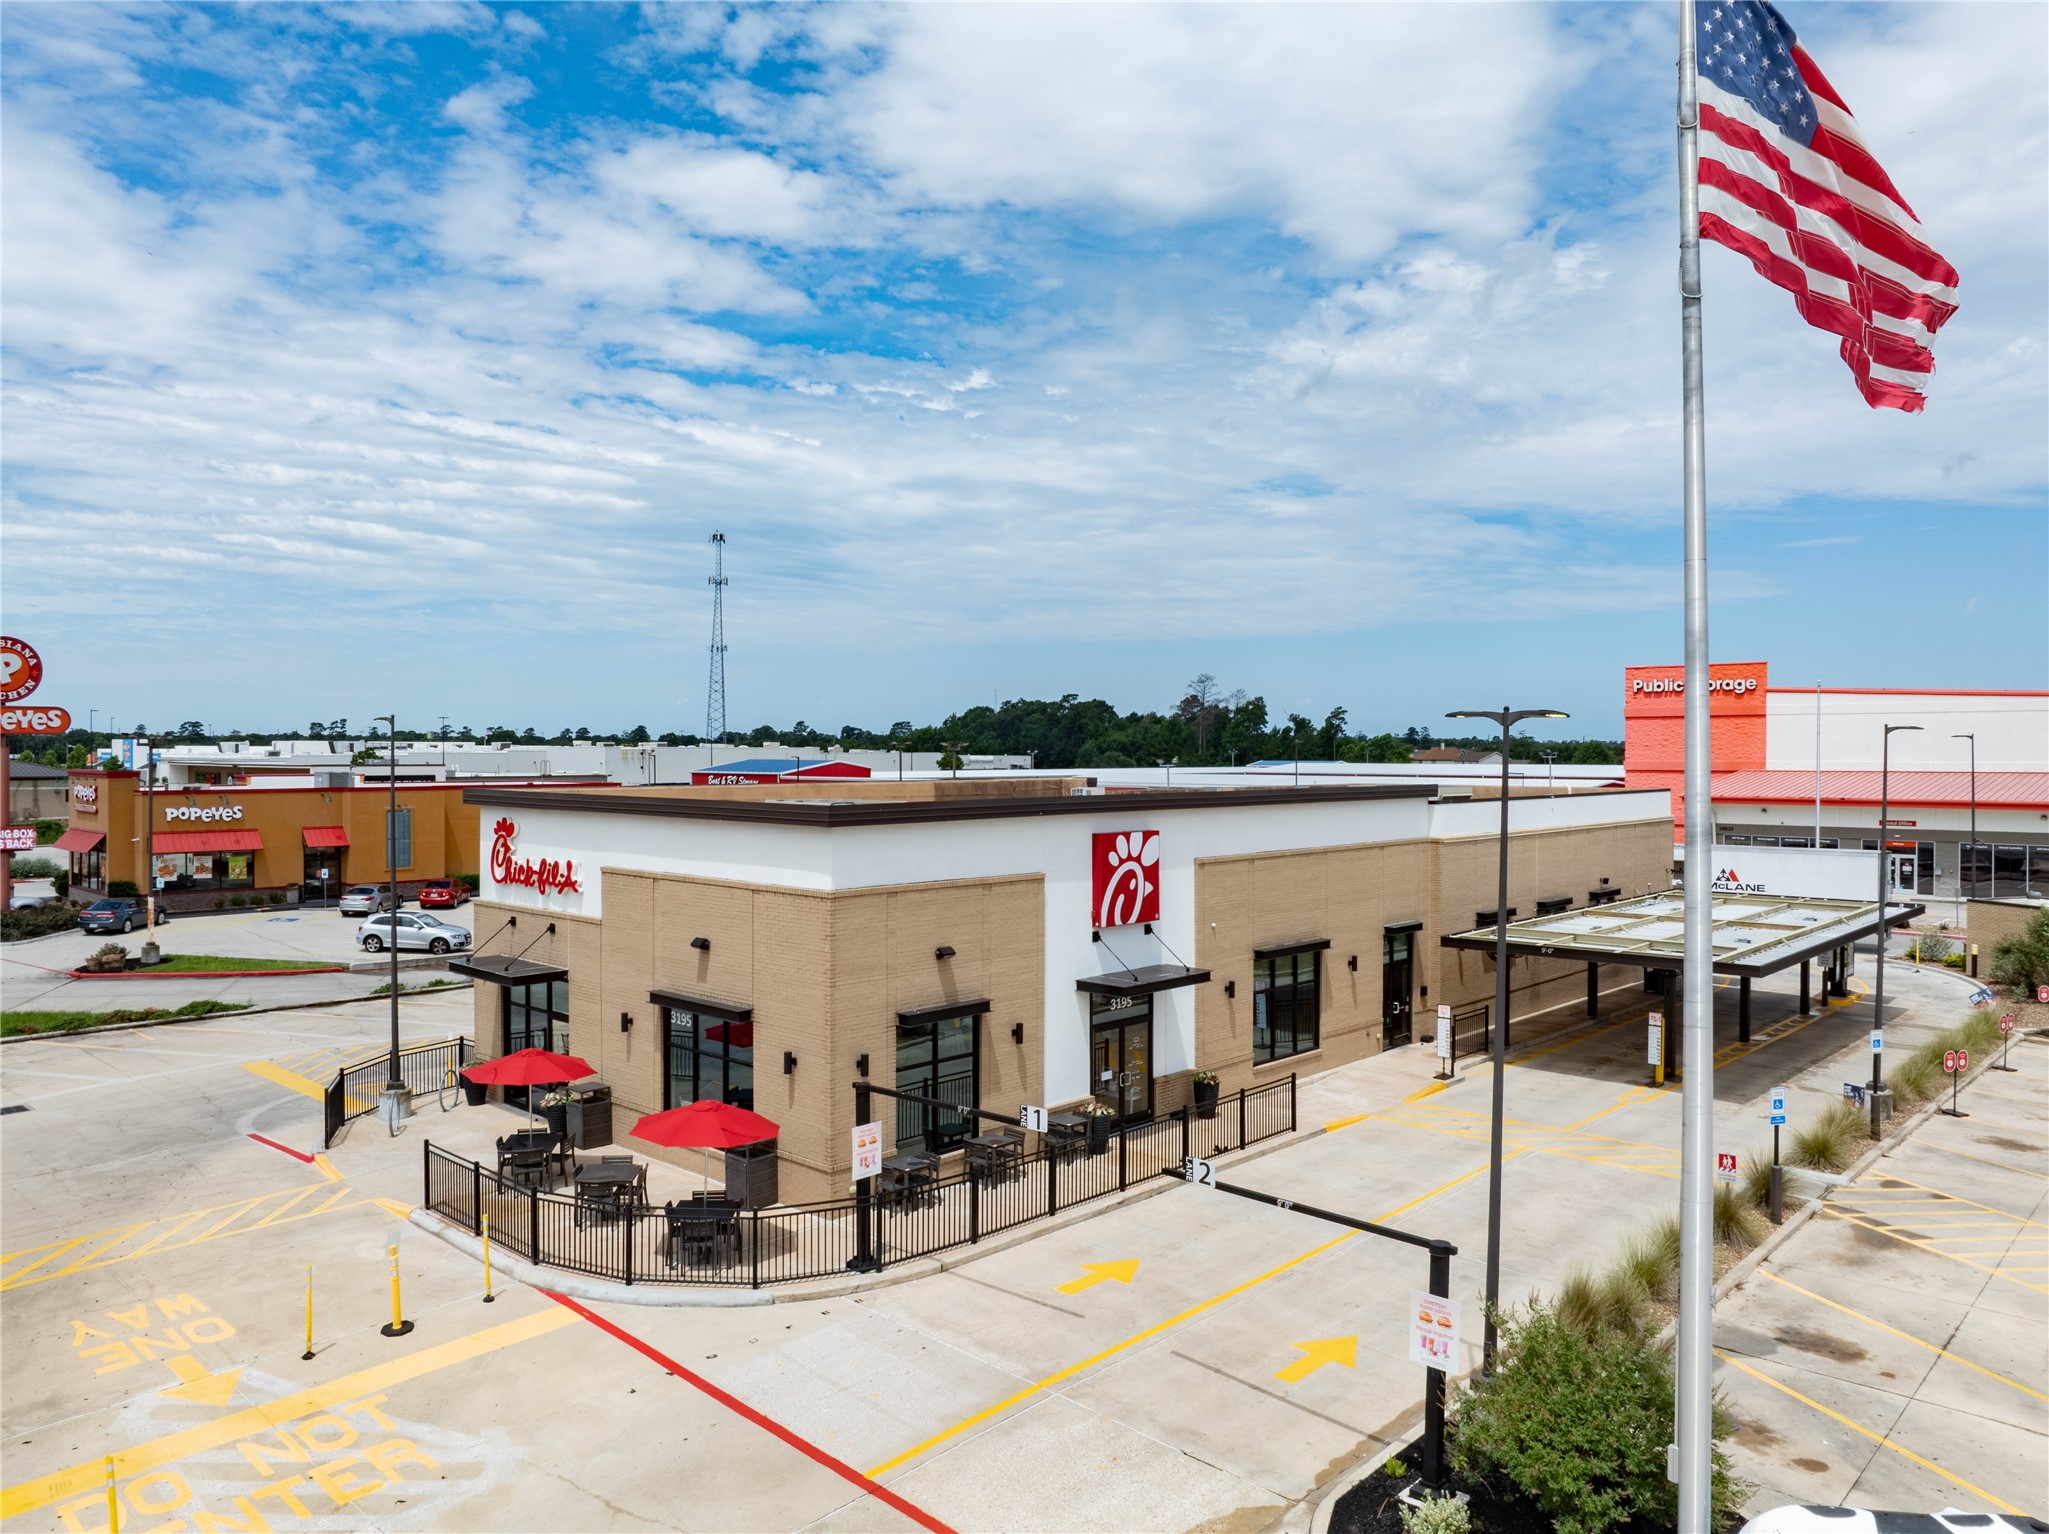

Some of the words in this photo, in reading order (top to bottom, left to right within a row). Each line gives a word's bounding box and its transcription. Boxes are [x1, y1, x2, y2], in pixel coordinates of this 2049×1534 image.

[1633, 678, 1684, 693] Public
[1709, 678, 1757, 694] orage
[0, 830, 11, 838] IG
[14, 829, 33, 838] BOX
[7, 839, 33, 848] BACK
[1110, 996, 1133, 1010] 3195
[670, 1011, 692, 1027] 3195
[1034, 1109, 1041, 1130] 1
[1185, 1156, 1194, 1182] LANE
[1199, 1162, 1212, 1186] 2
[70, 1292, 211, 1347] WAY
[77, 1316, 237, 1375] ONE
[56, 1471, 193, 1534] DO
[236, 1394, 398, 1477] NOT
